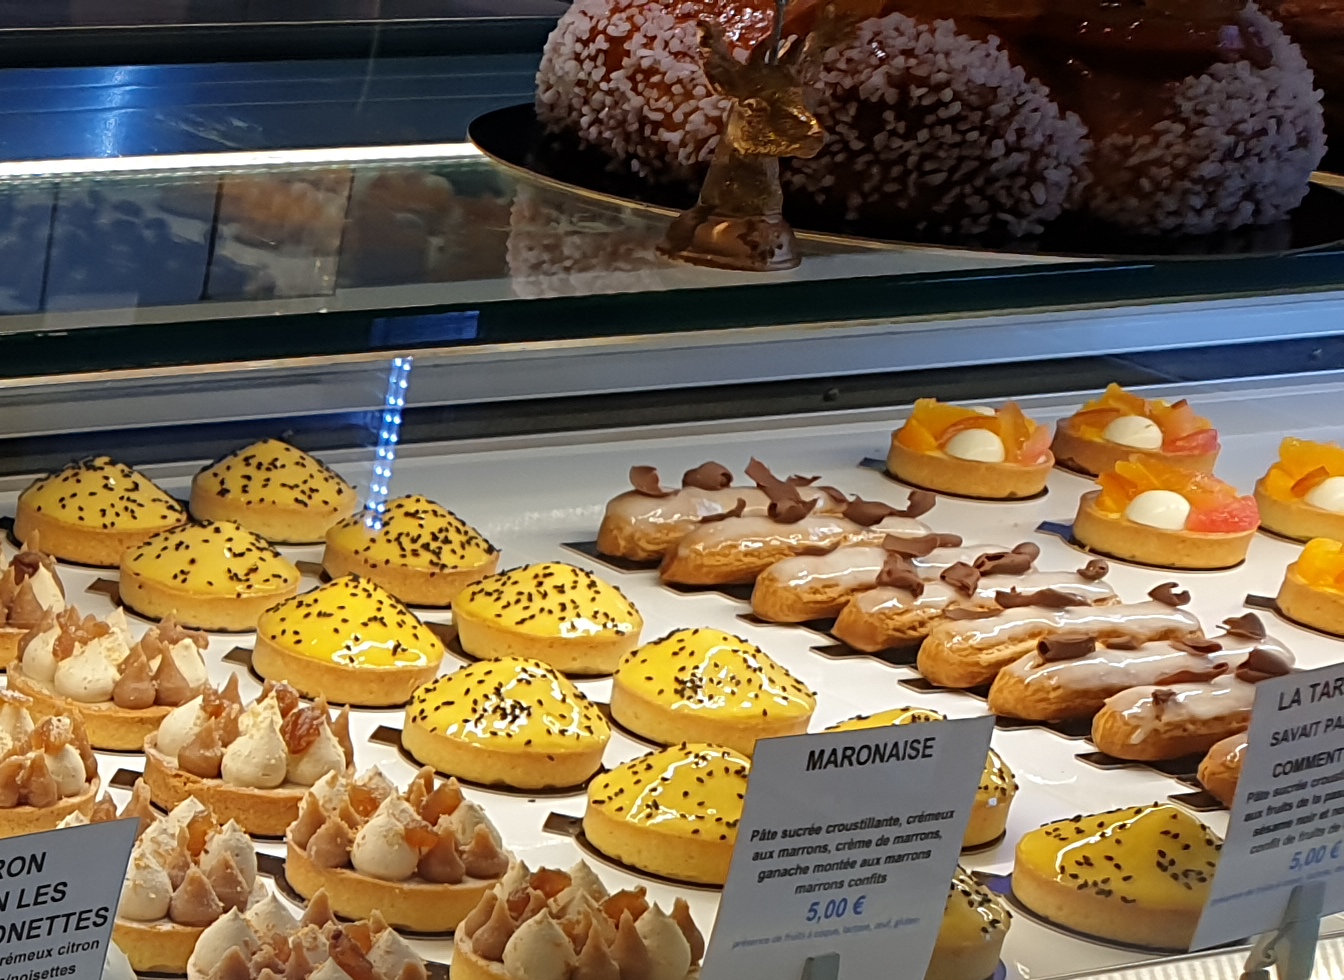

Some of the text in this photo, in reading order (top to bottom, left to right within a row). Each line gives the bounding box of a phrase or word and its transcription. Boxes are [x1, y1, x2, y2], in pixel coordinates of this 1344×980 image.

[1278, 687, 1302, 711] LA
[1270, 721, 1321, 746] SAVAIT
[806, 737, 935, 771] MARONAISE
[1273, 748, 1344, 778] COMMENT
[750, 809, 955, 842] Pâte sucrée croustillante, crémeux
[752, 829, 942, 861] aux marrons, crème de marrons,
[1289, 840, 1342, 870] 5,00 €
[757, 849, 931, 883] ganache montée aux marrons
[17, 881, 67, 909] LES
[795, 873, 887, 894] marrons confits
[806, 895, 866, 924] 5,00 €
[58, 938, 99, 959] citron
